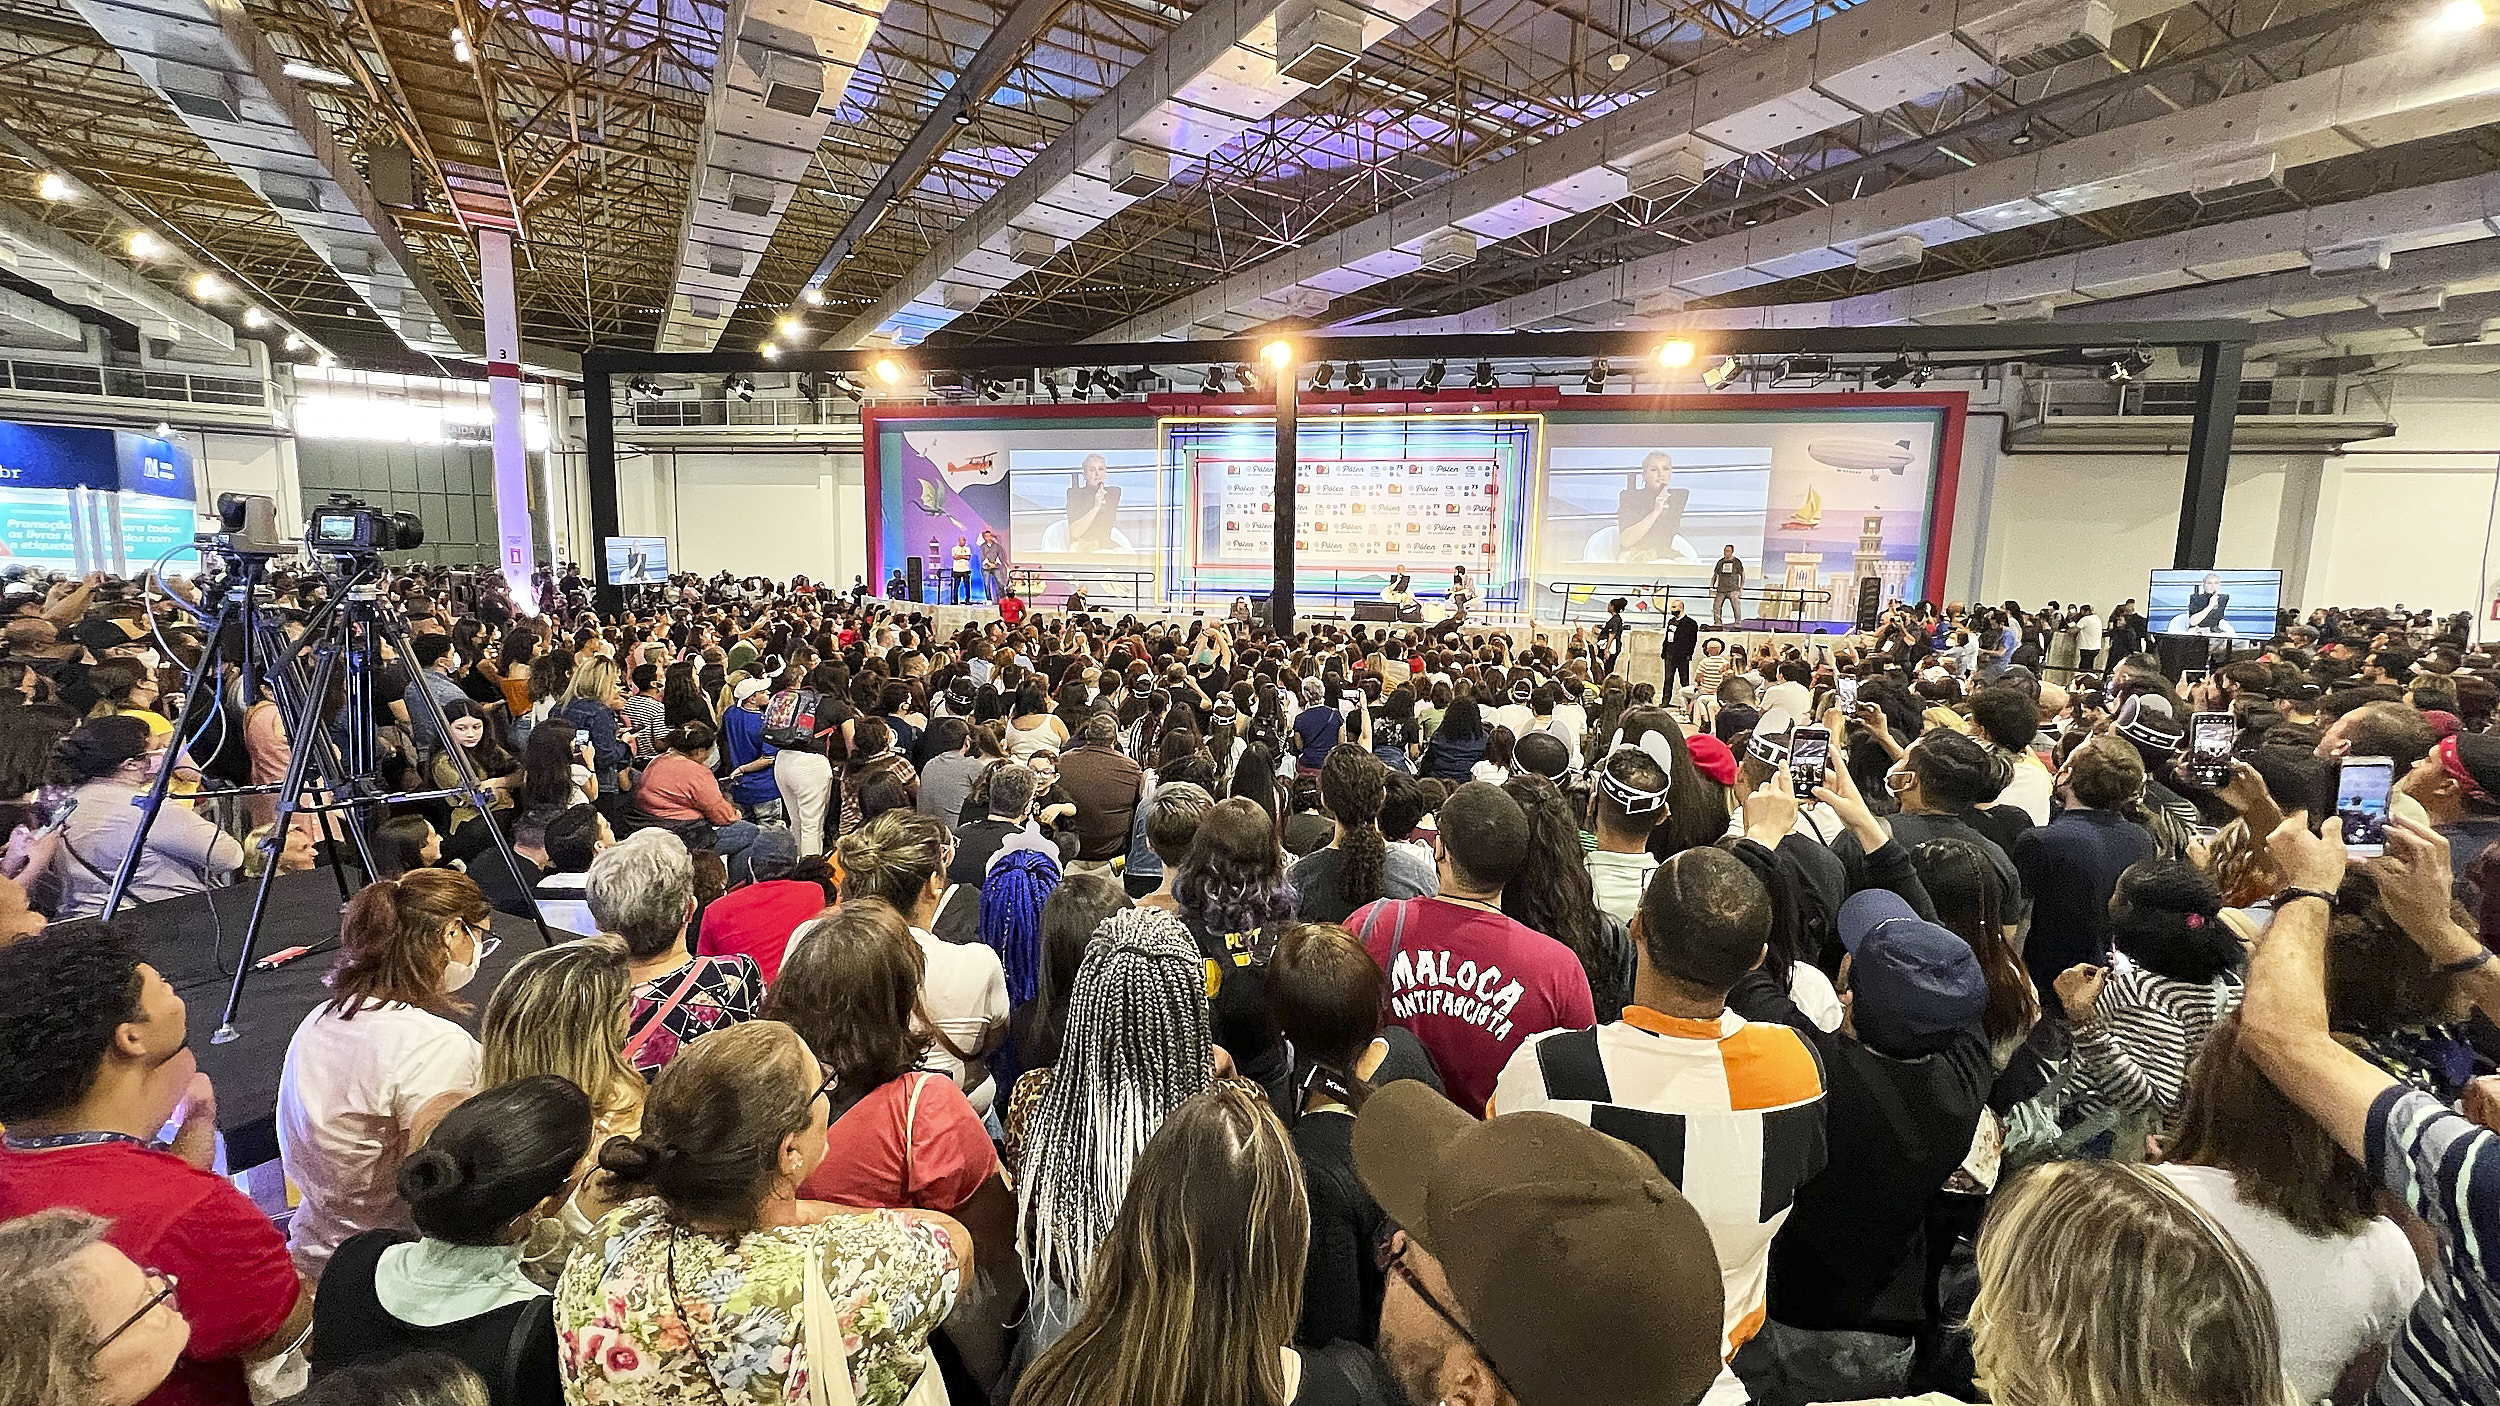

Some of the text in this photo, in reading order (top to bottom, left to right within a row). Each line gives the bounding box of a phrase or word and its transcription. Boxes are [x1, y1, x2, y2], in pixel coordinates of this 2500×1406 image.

[499, 349, 507, 359] 3
[1390, 949, 1525, 1017] MALOCA
[1391, 989, 1515, 1042] ANTIFASCISTA
